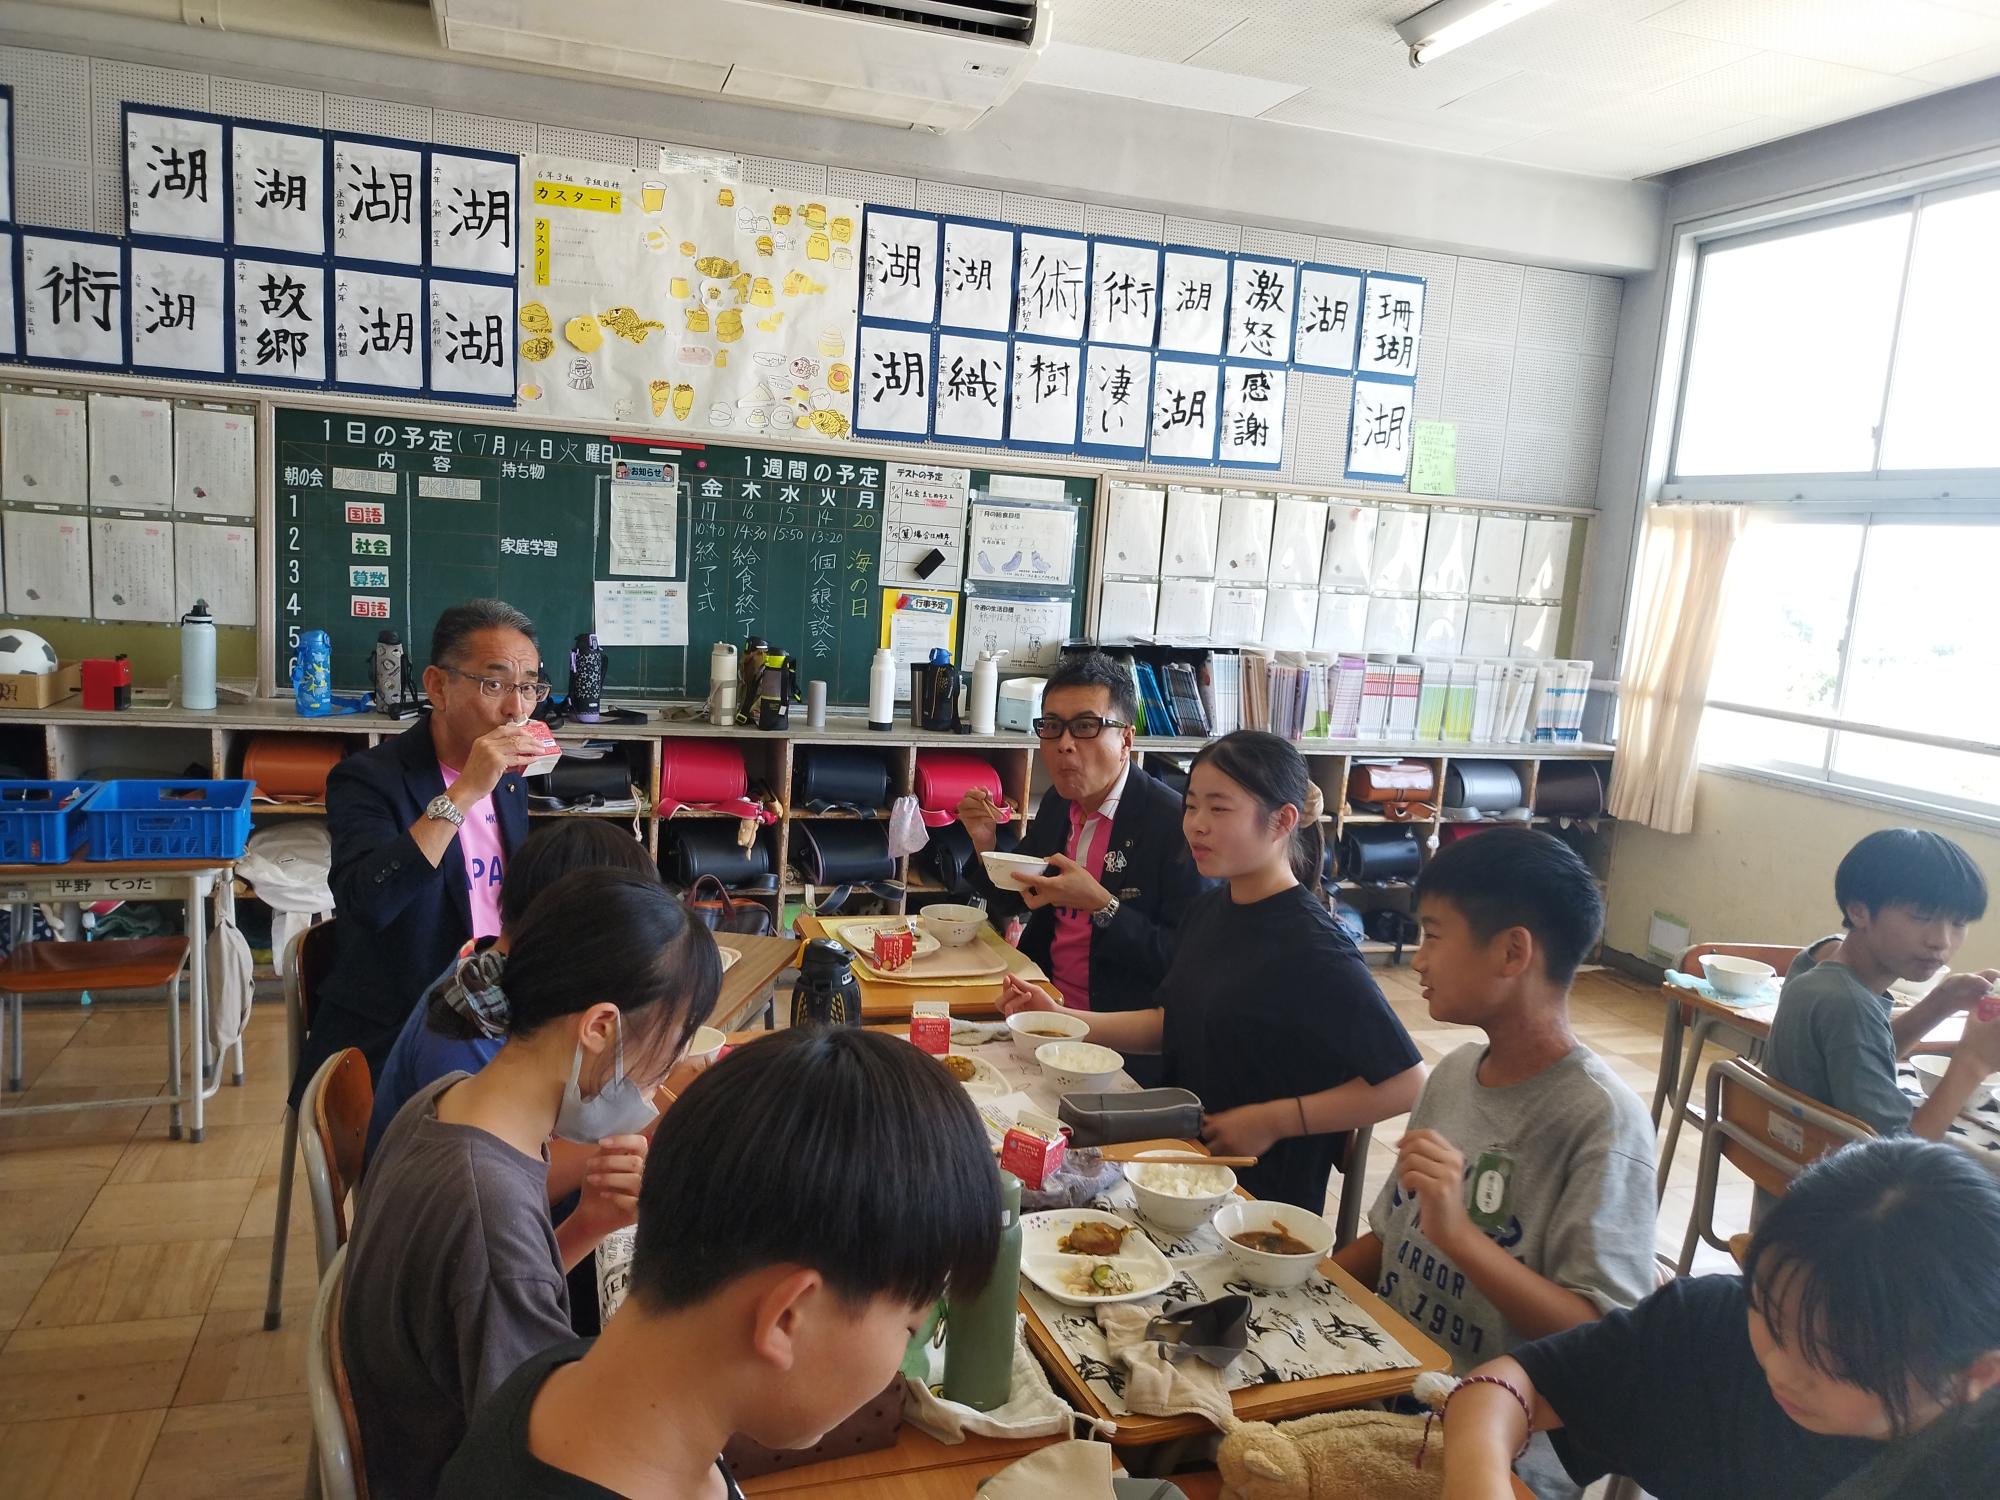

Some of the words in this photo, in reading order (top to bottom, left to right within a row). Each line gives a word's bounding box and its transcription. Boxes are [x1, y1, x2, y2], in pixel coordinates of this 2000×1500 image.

[146, 145, 208, 203] 湖
[254, 167, 307, 211] 湖
[347, 163, 412, 225] 湖
[536, 186, 621, 209] カスタード
[447, 187, 510, 249] 湖
[536, 220, 547, 284] カスタード
[876, 242, 921, 288] 湖
[952, 256, 992, 292] 湖
[1029, 254, 1084, 321] 術
[36, 261, 121, 332] 術
[145, 286, 195, 334] 湖
[1103, 271, 1156, 323] 術
[1176, 280, 1212, 312] 湖
[255, 273, 313, 374] 故郷
[1239, 269, 1286, 357] 激怒
[1305, 295, 1349, 333] 湖
[358, 306, 413, 355] 湖
[445, 312, 504, 368] 湖
[1373, 294, 1415, 369] 珊瑚
[871, 351, 924, 402] 湖
[947, 355, 1002, 408] 織
[1027, 354, 1071, 403] 樹
[1099, 363, 1134, 433] 凄い
[1160, 388, 1207, 430] 湖
[1233, 369, 1274, 447] 感謝
[323, 418, 453, 453] 1日の予定
[1363, 402, 1406, 452] 湖
[283, 466, 324, 488] 朝の会
[334, 468, 397, 494] 火曜日
[501, 461, 546, 480] 持ち物
[631, 467, 662, 478] お知らせ
[744, 455, 880, 489] 1週間の予定
[897, 468, 943, 482] テストの予定
[419, 477, 481, 500] 水曜日
[701, 477, 724, 498] 金
[741, 480, 762, 500] 木
[779, 484, 801, 503] 水
[819, 487, 836, 507] 火
[856, 490, 875, 510] 月
[289, 494, 297, 518] 1
[347, 506, 383, 524] 国語
[742, 503, 755, 520] 16
[779, 506, 797, 528] 15
[817, 509, 833, 527] 14
[733, 523, 767, 540] 14:30
[773, 525, 804, 541] 15:50
[852, 513, 875, 529] 20
[289, 526, 300, 551] 2
[355, 537, 388, 555] 社会
[500, 537, 558, 557] 家庭学習
[811, 530, 843, 544] 13:20
[289, 559, 300, 584] 3
[352, 570, 387, 587] 算数
[694, 540, 720, 612] 終了式
[846, 547, 873, 619] 海の日
[286, 592, 302, 617] 4
[731, 541, 761, 639] 給食終了
[807, 549, 837, 658] 個人懇談会
[915, 599, 947, 610] 行事予定
[353, 601, 388, 617] 国語
[974, 604, 1015, 613] 今週の生活目標
[288, 625, 301, 648] 5
[55, 878, 92, 892] 平野
[104, 877, 153, 891] てった
[1409, 1293, 1484, 1354] 1997
